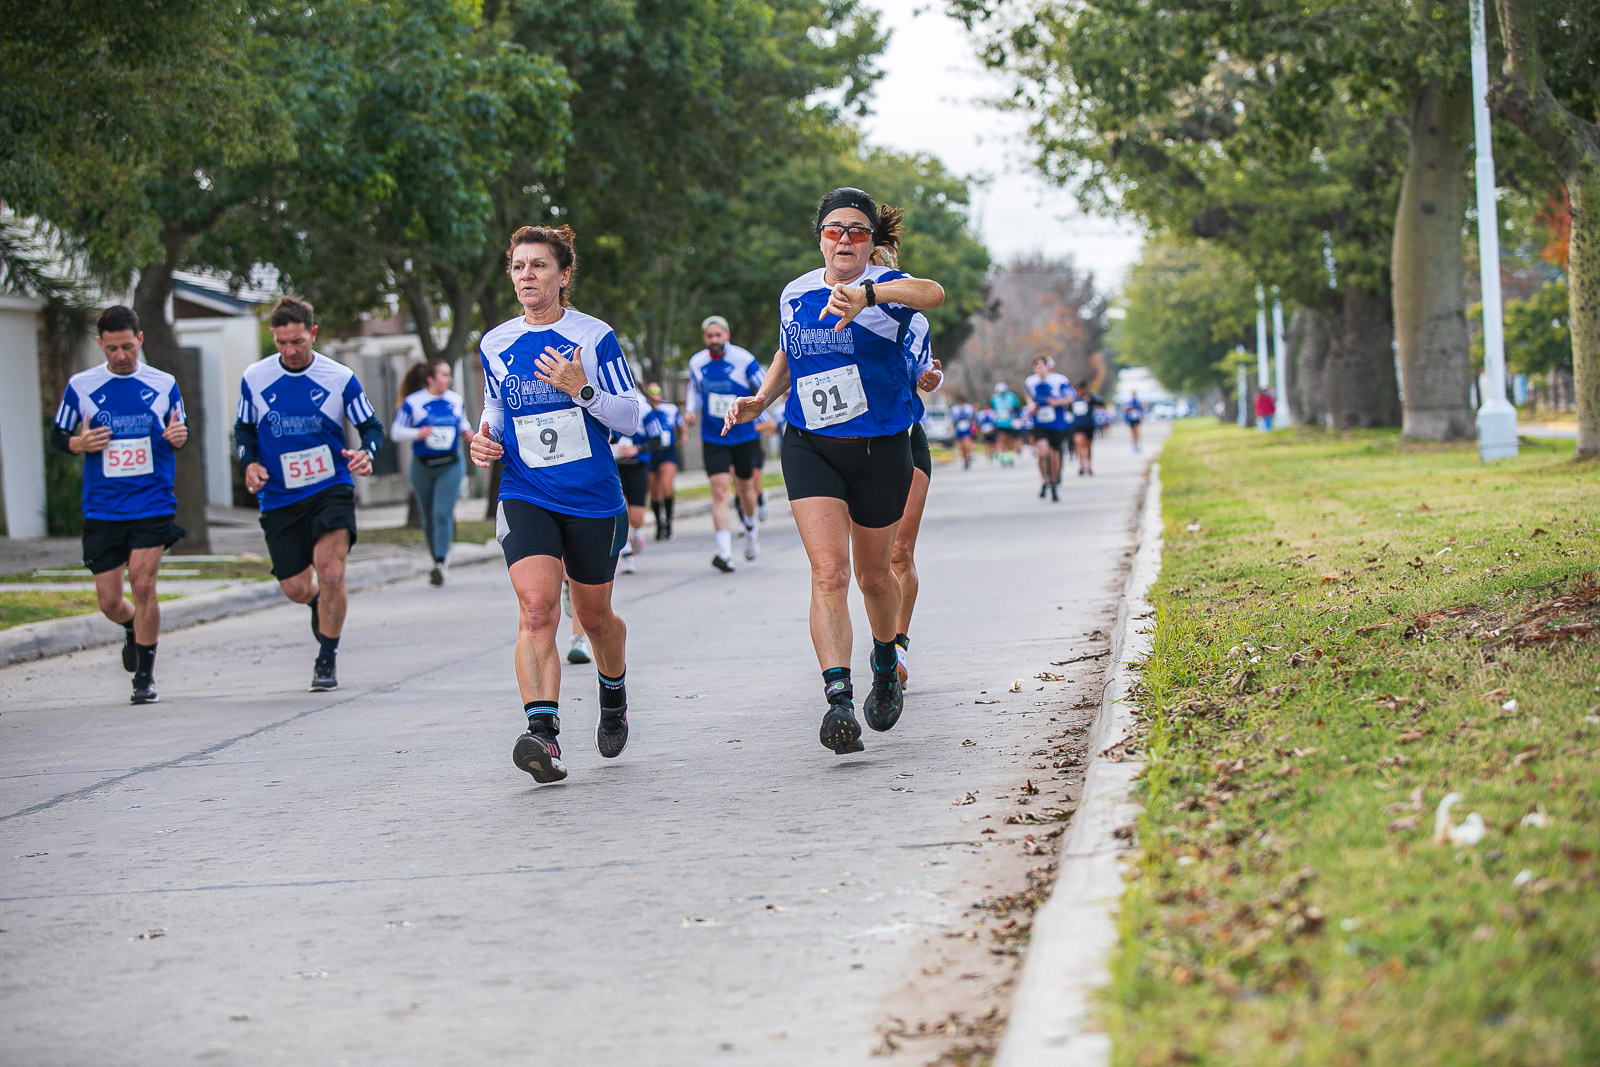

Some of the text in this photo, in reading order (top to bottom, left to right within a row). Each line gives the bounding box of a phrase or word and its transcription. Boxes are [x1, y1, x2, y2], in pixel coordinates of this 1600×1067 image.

[788, 322, 802, 359] 3
[506, 374, 522, 410] 3
[812, 385, 848, 415] 91
[267, 410, 282, 438] 3
[539, 428, 558, 453] 9
[109, 448, 147, 467] 528
[289, 456, 328, 479] 511
